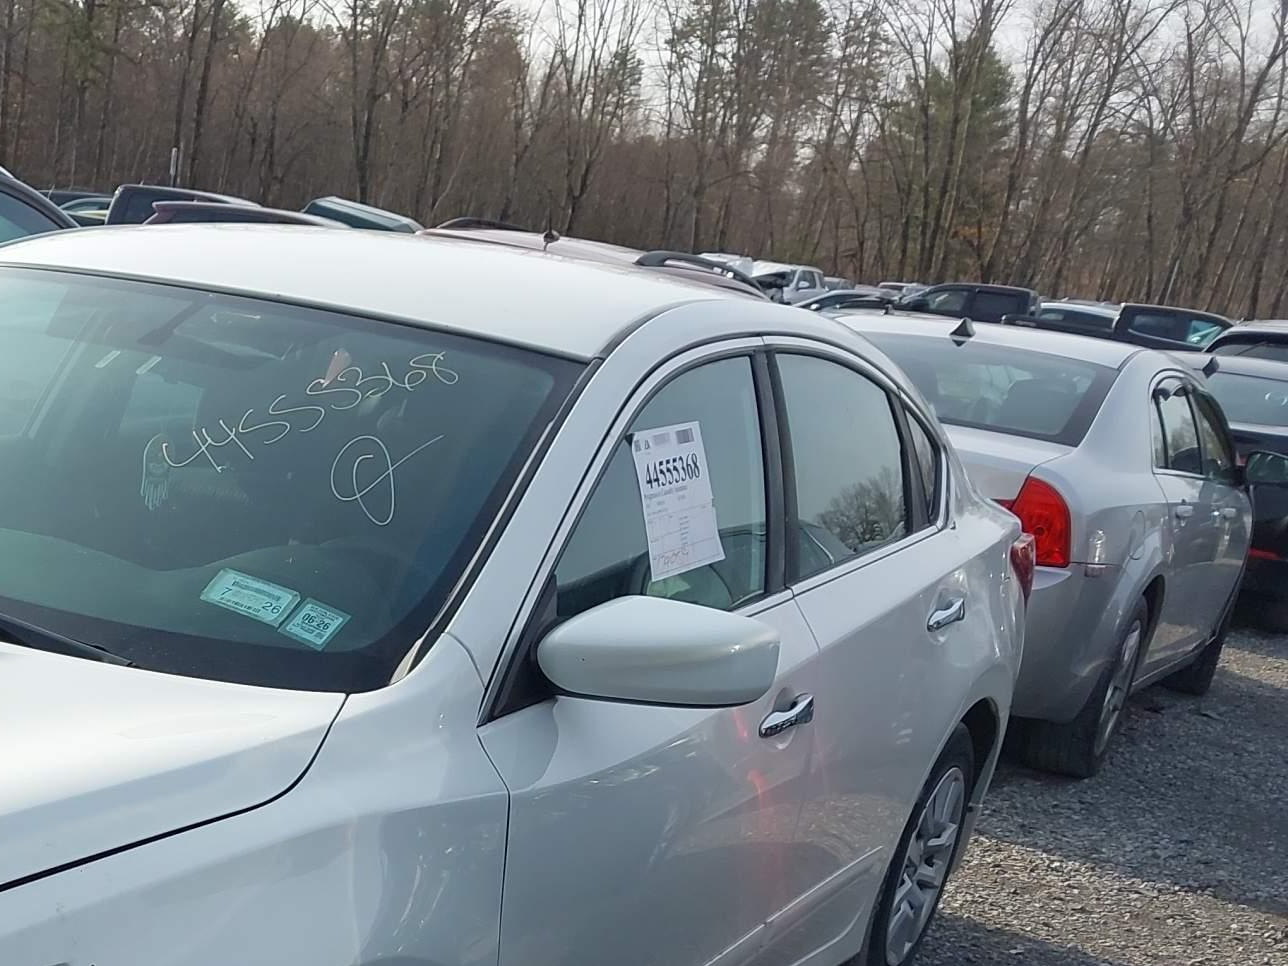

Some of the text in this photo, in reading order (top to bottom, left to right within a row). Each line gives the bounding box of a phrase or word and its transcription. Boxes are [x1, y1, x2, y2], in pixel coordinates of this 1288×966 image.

[162, 351, 459, 474] 44555368
[645, 451, 701, 489] 44555368
[261, 601, 283, 615] 26
